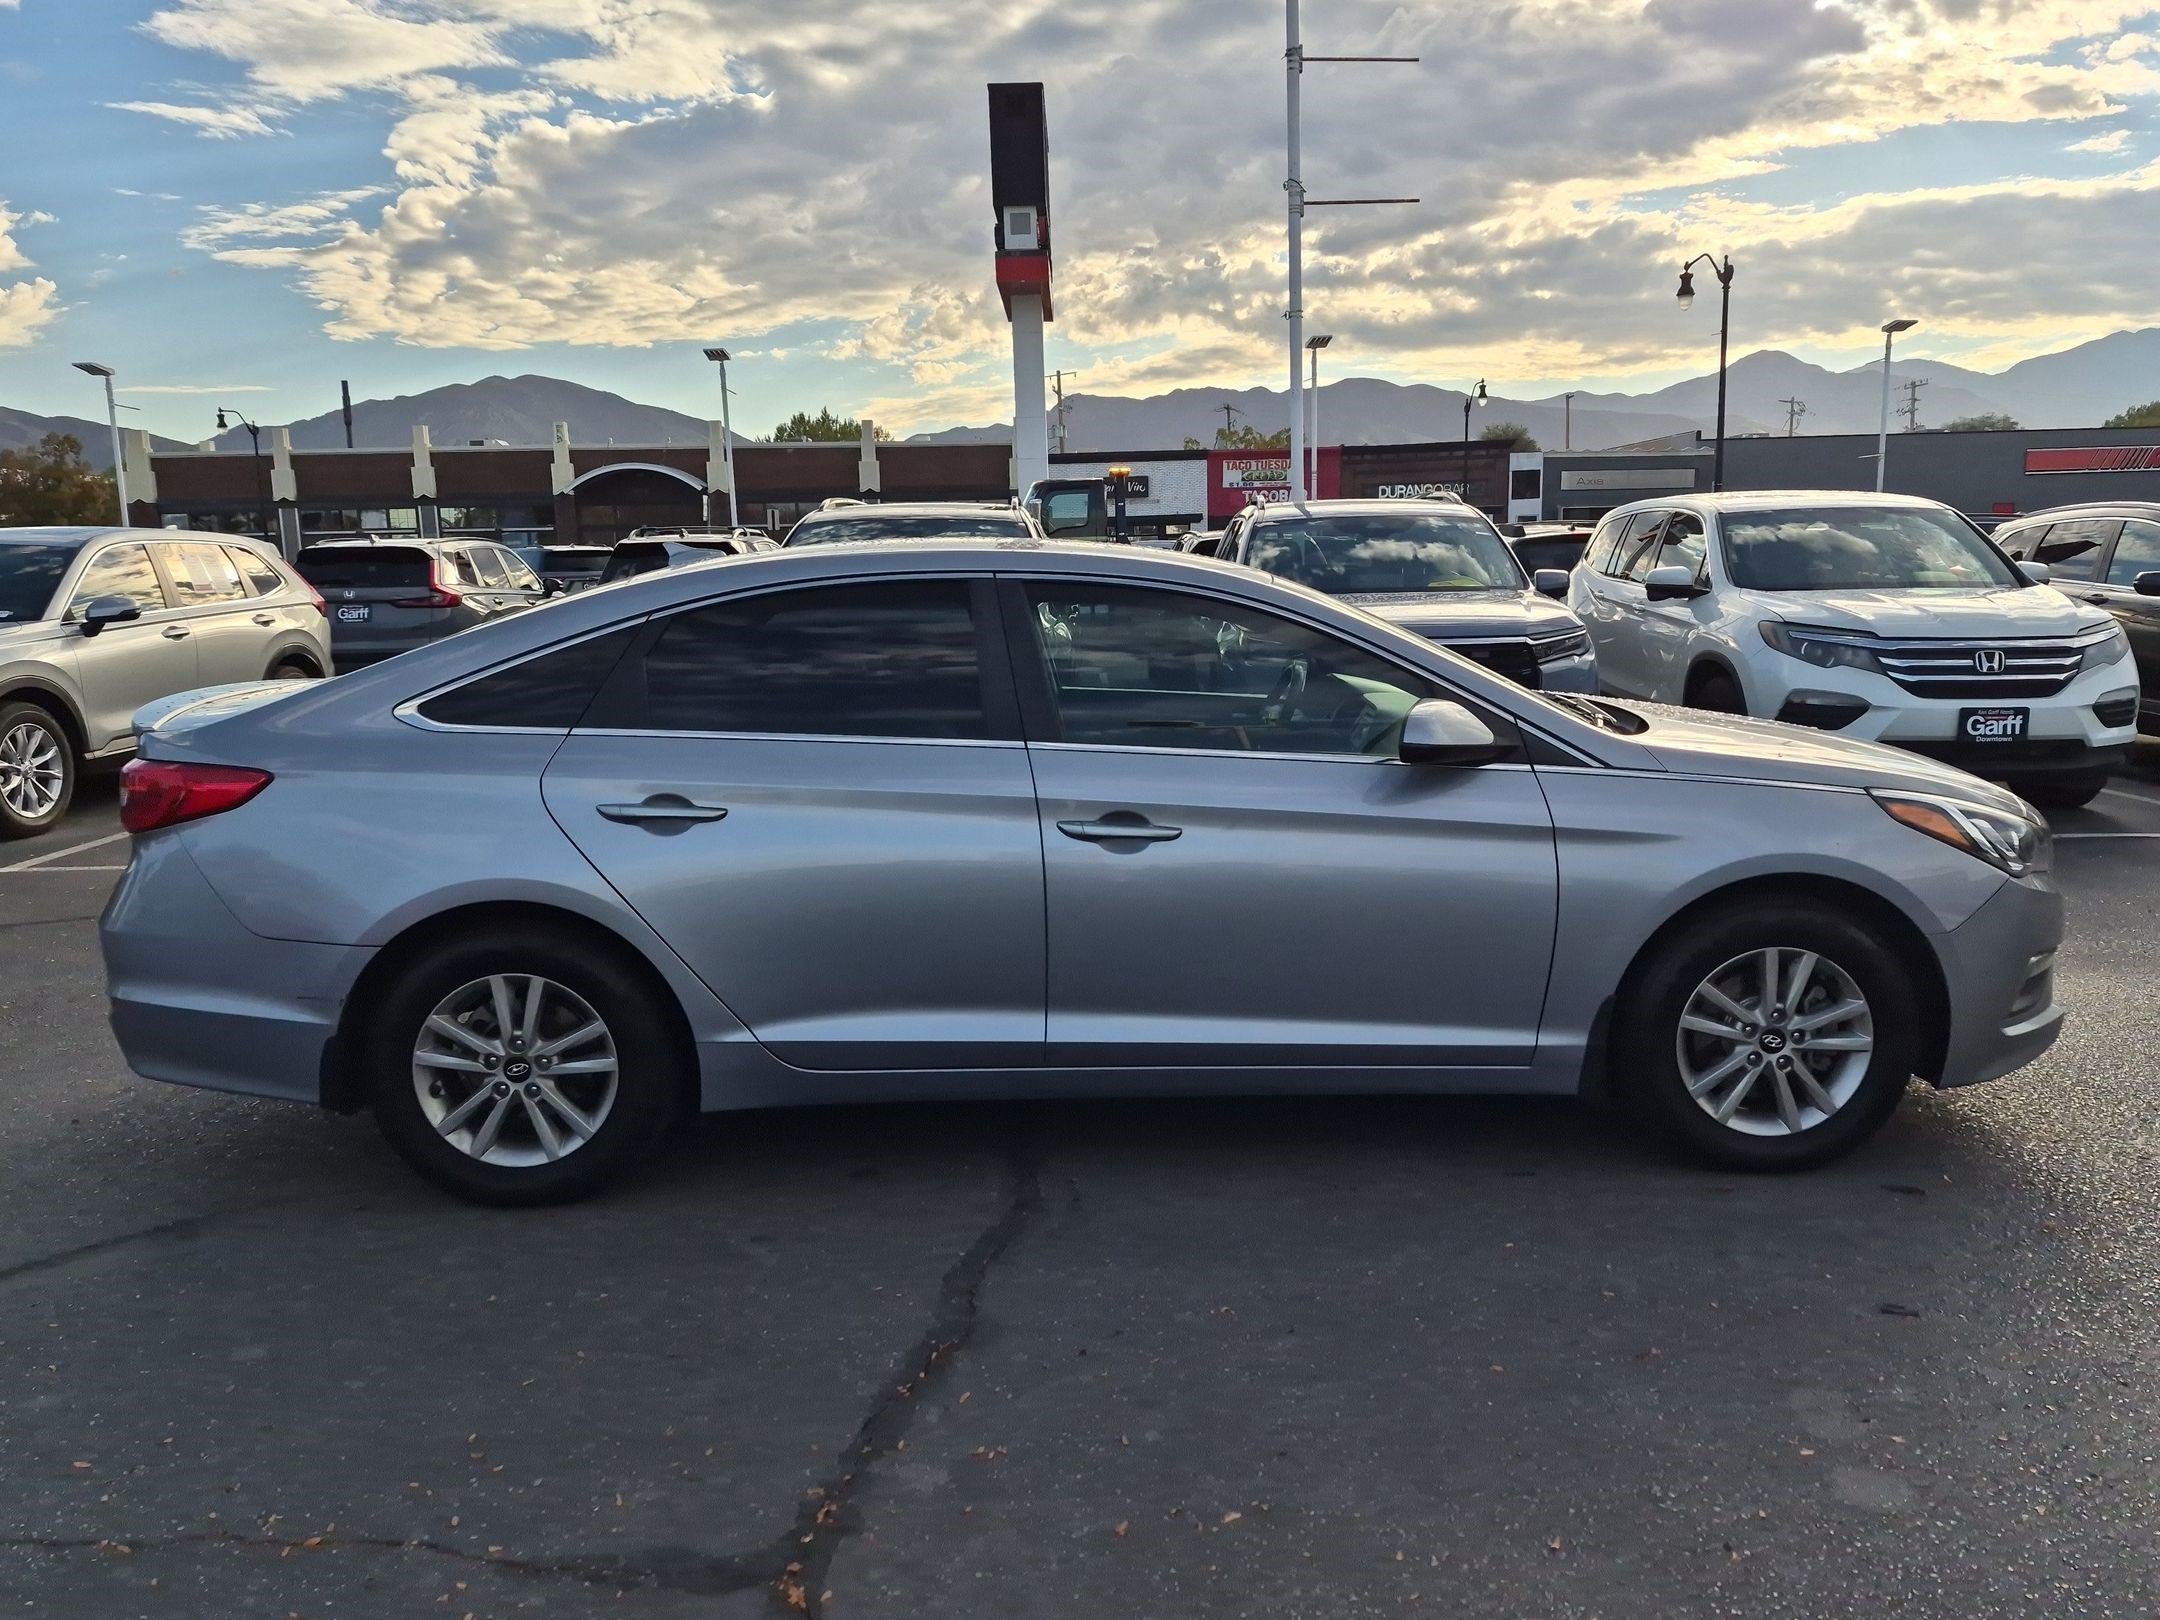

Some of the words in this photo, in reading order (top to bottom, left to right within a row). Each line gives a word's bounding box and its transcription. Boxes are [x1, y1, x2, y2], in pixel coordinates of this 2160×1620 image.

[1225, 461, 1252, 471] TACO
[1254, 461, 1292, 470] TUESD
[338, 608, 368, 618] Garff
[1966, 715, 2023, 736] Garff
